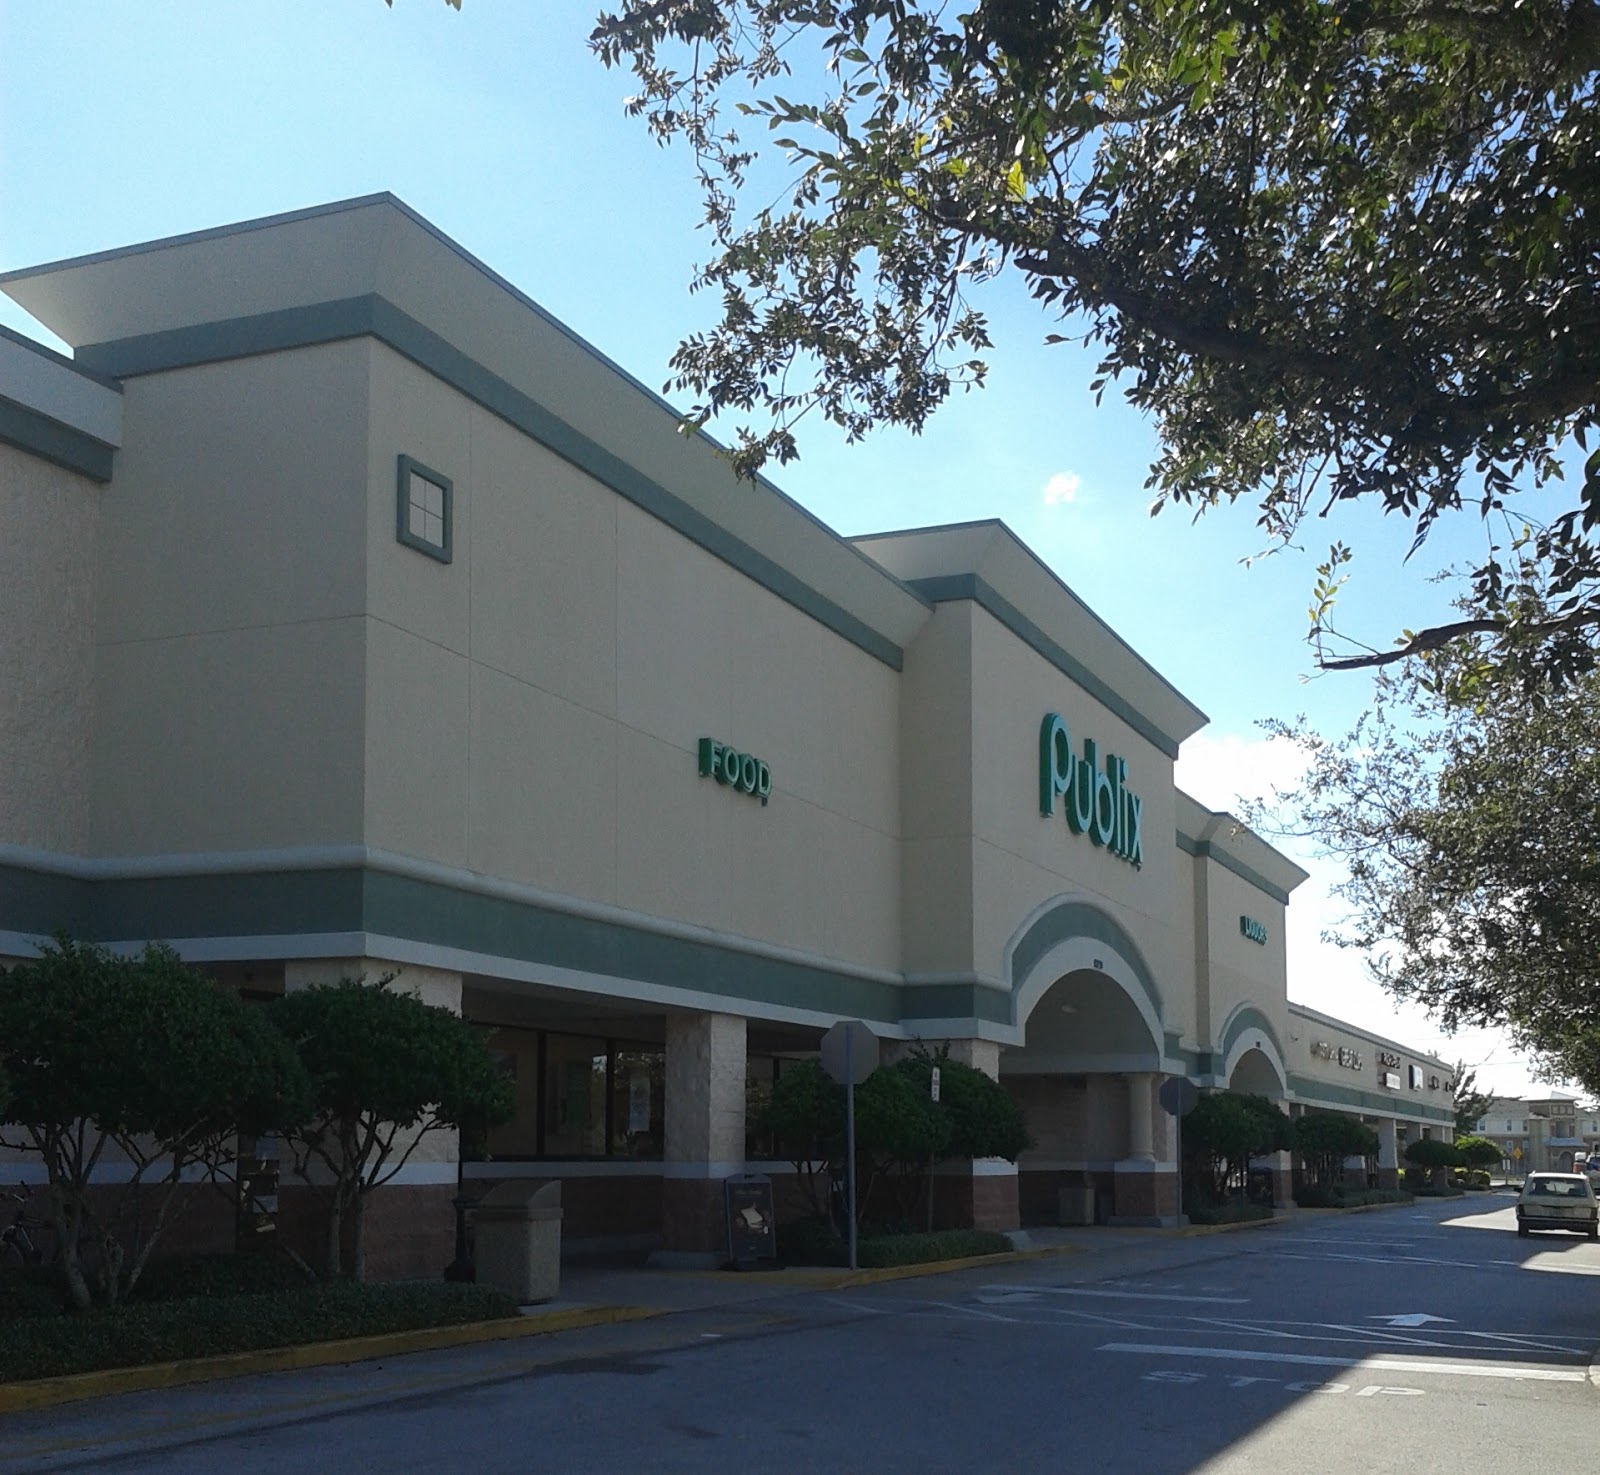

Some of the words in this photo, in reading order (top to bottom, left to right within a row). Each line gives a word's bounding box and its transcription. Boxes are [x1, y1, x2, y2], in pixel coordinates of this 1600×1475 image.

[698, 737, 772, 801] FOOD
[1039, 712, 1143, 868] Publix
[1141, 1369, 1426, 1398] STOP
